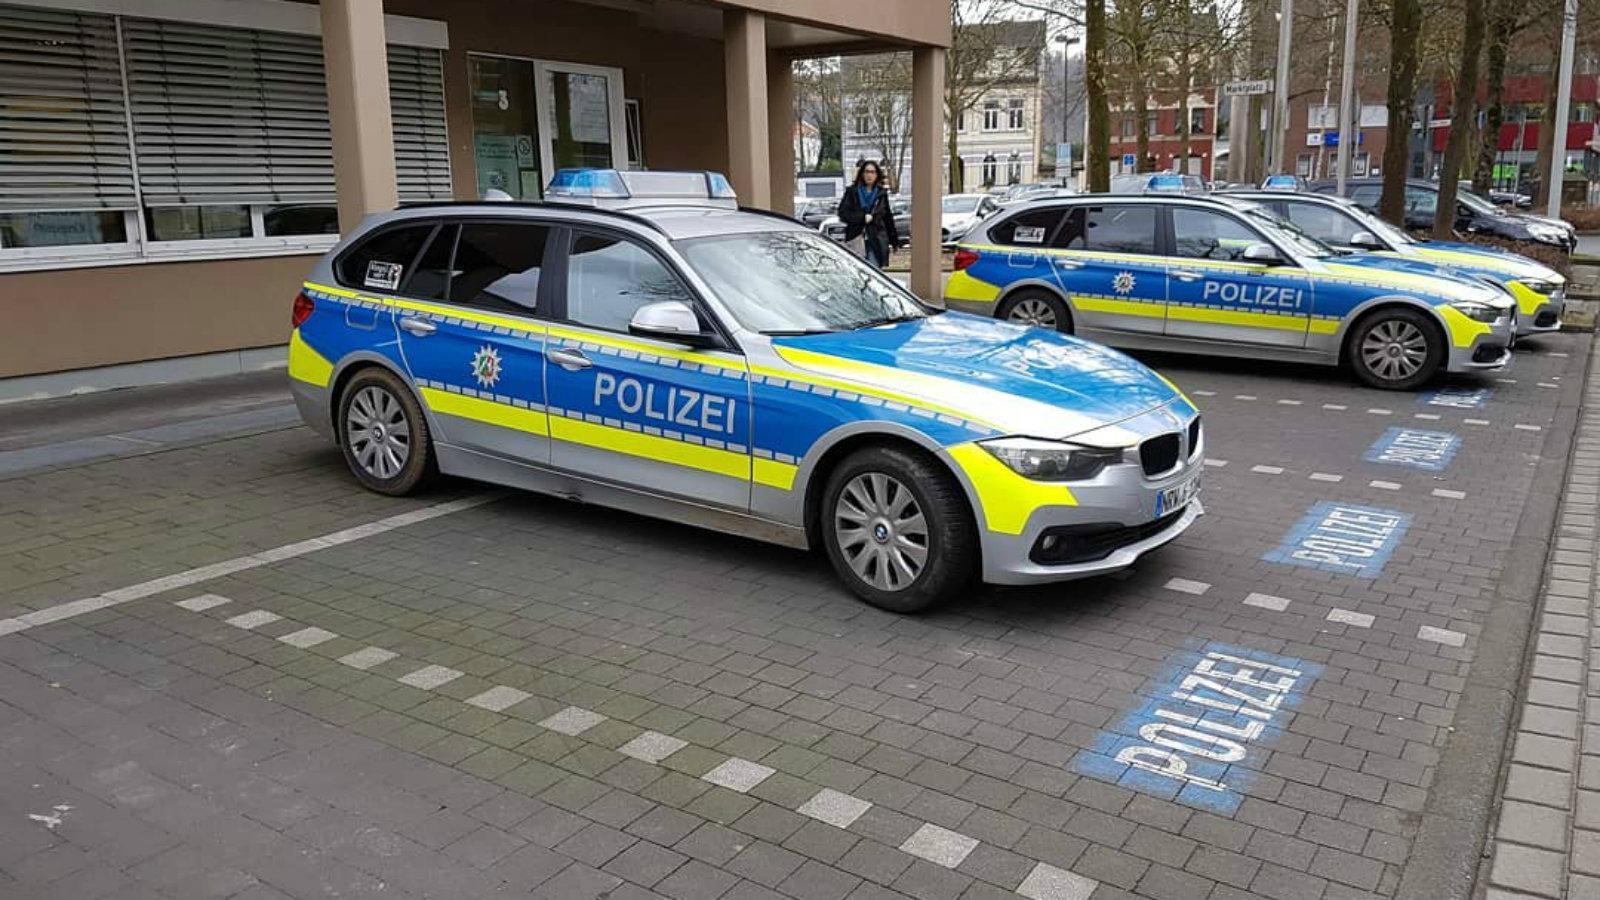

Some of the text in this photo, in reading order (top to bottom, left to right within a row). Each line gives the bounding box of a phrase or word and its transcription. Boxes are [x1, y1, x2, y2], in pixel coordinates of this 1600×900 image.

[498, 89, 509, 110] 3
[1203, 280, 1303, 308] POLIZEI
[594, 372, 736, 434] POLIZEI
[1292, 507, 1401, 567] POLIZEI
[1114, 652, 1302, 791] POLIZEI
